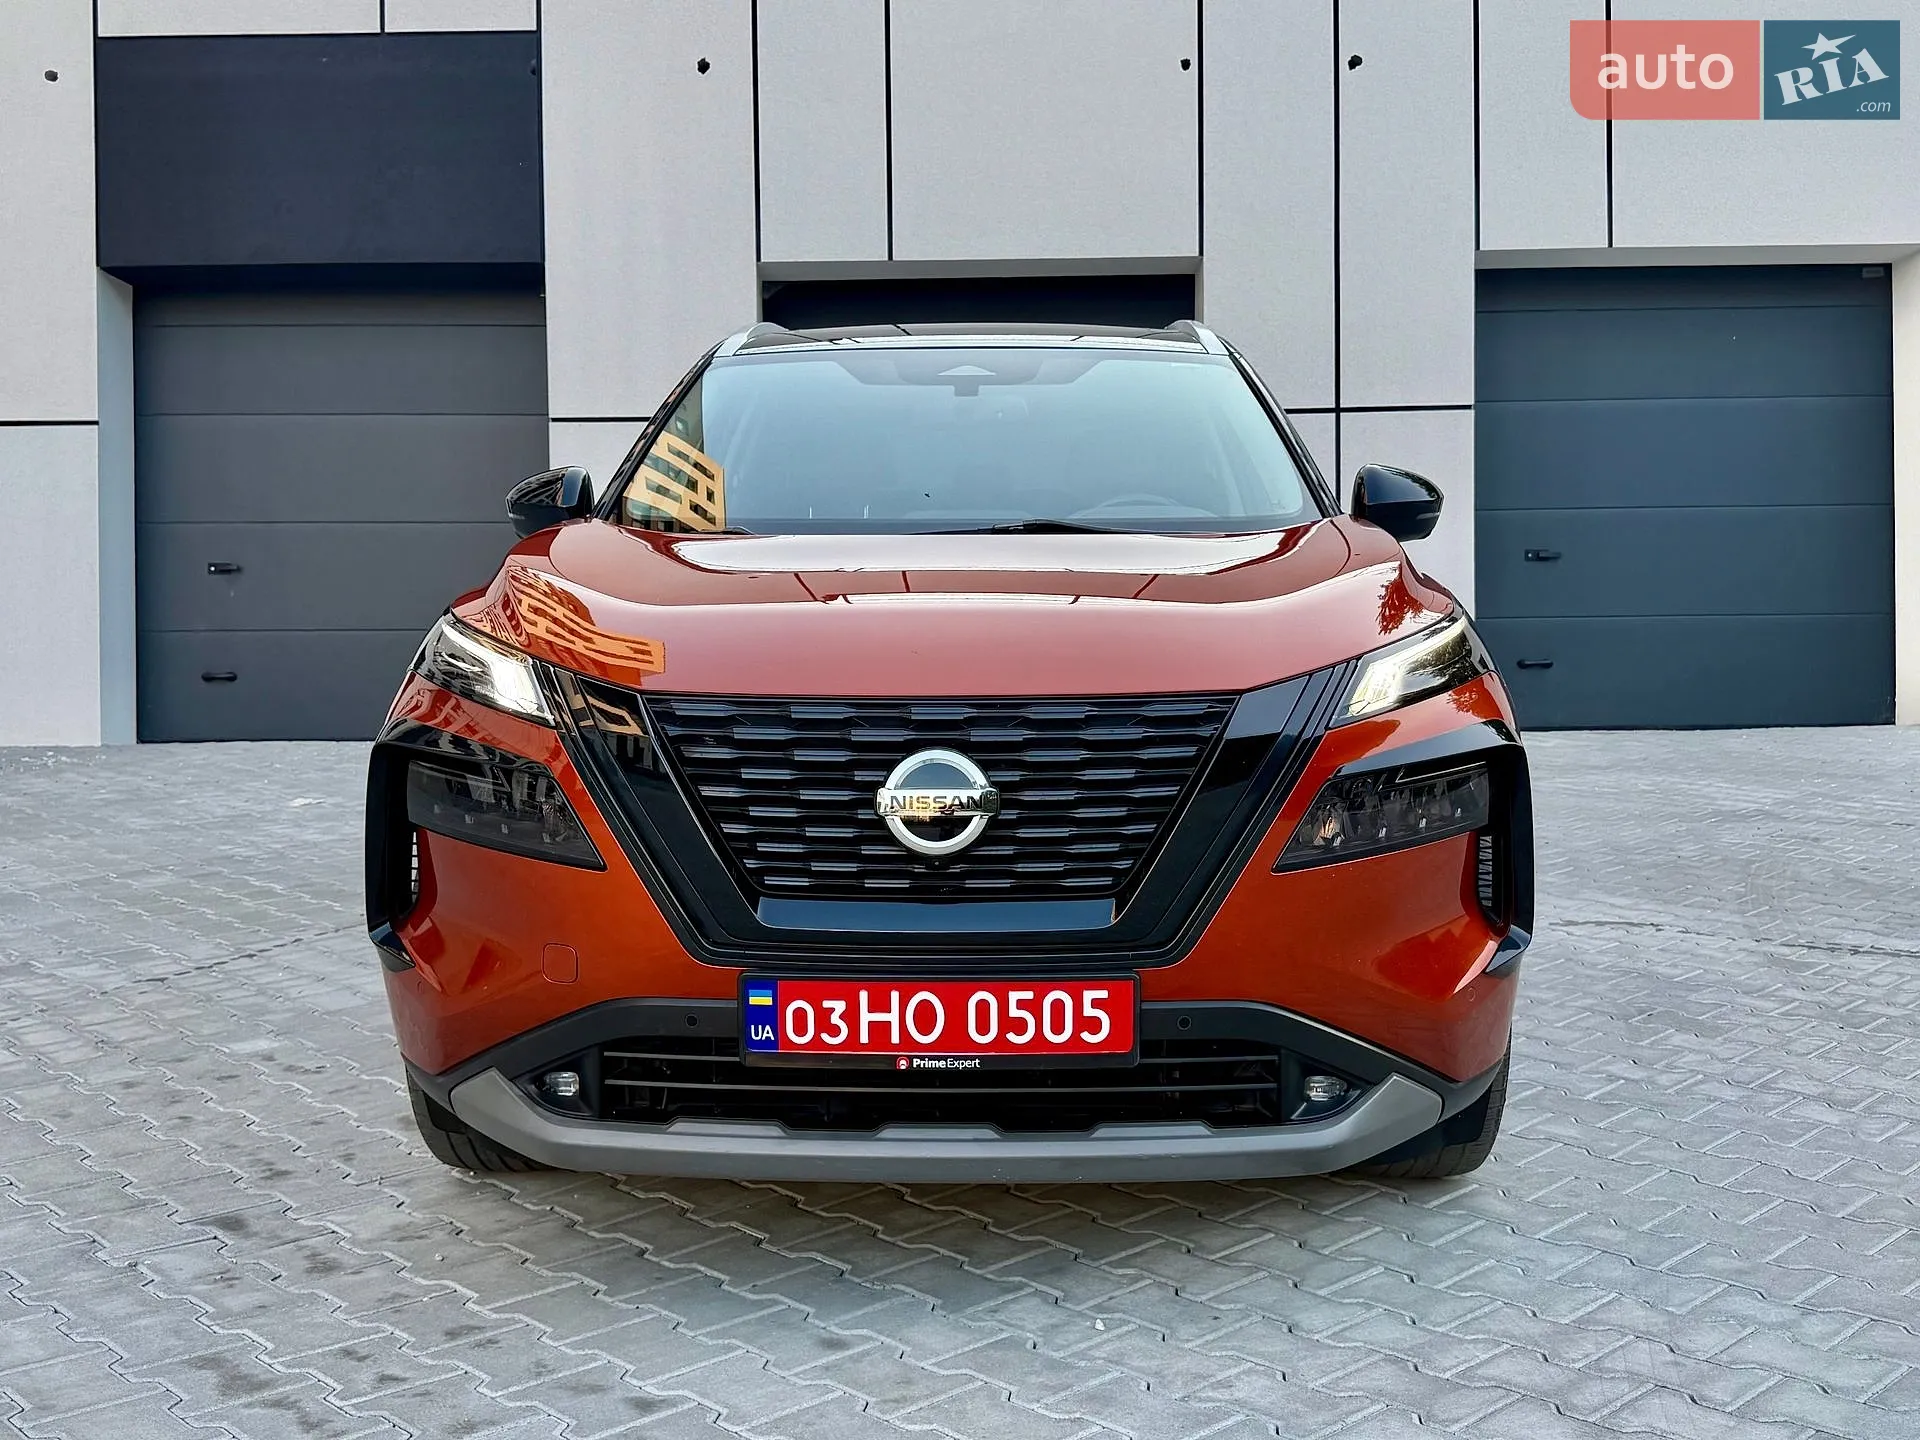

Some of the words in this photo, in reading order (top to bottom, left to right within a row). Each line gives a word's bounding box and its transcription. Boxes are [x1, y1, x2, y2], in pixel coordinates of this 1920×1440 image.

[889, 795, 983, 810] NISSAN
[966, 989, 1111, 1044] 0505
[750, 1024, 775, 1041] UA
